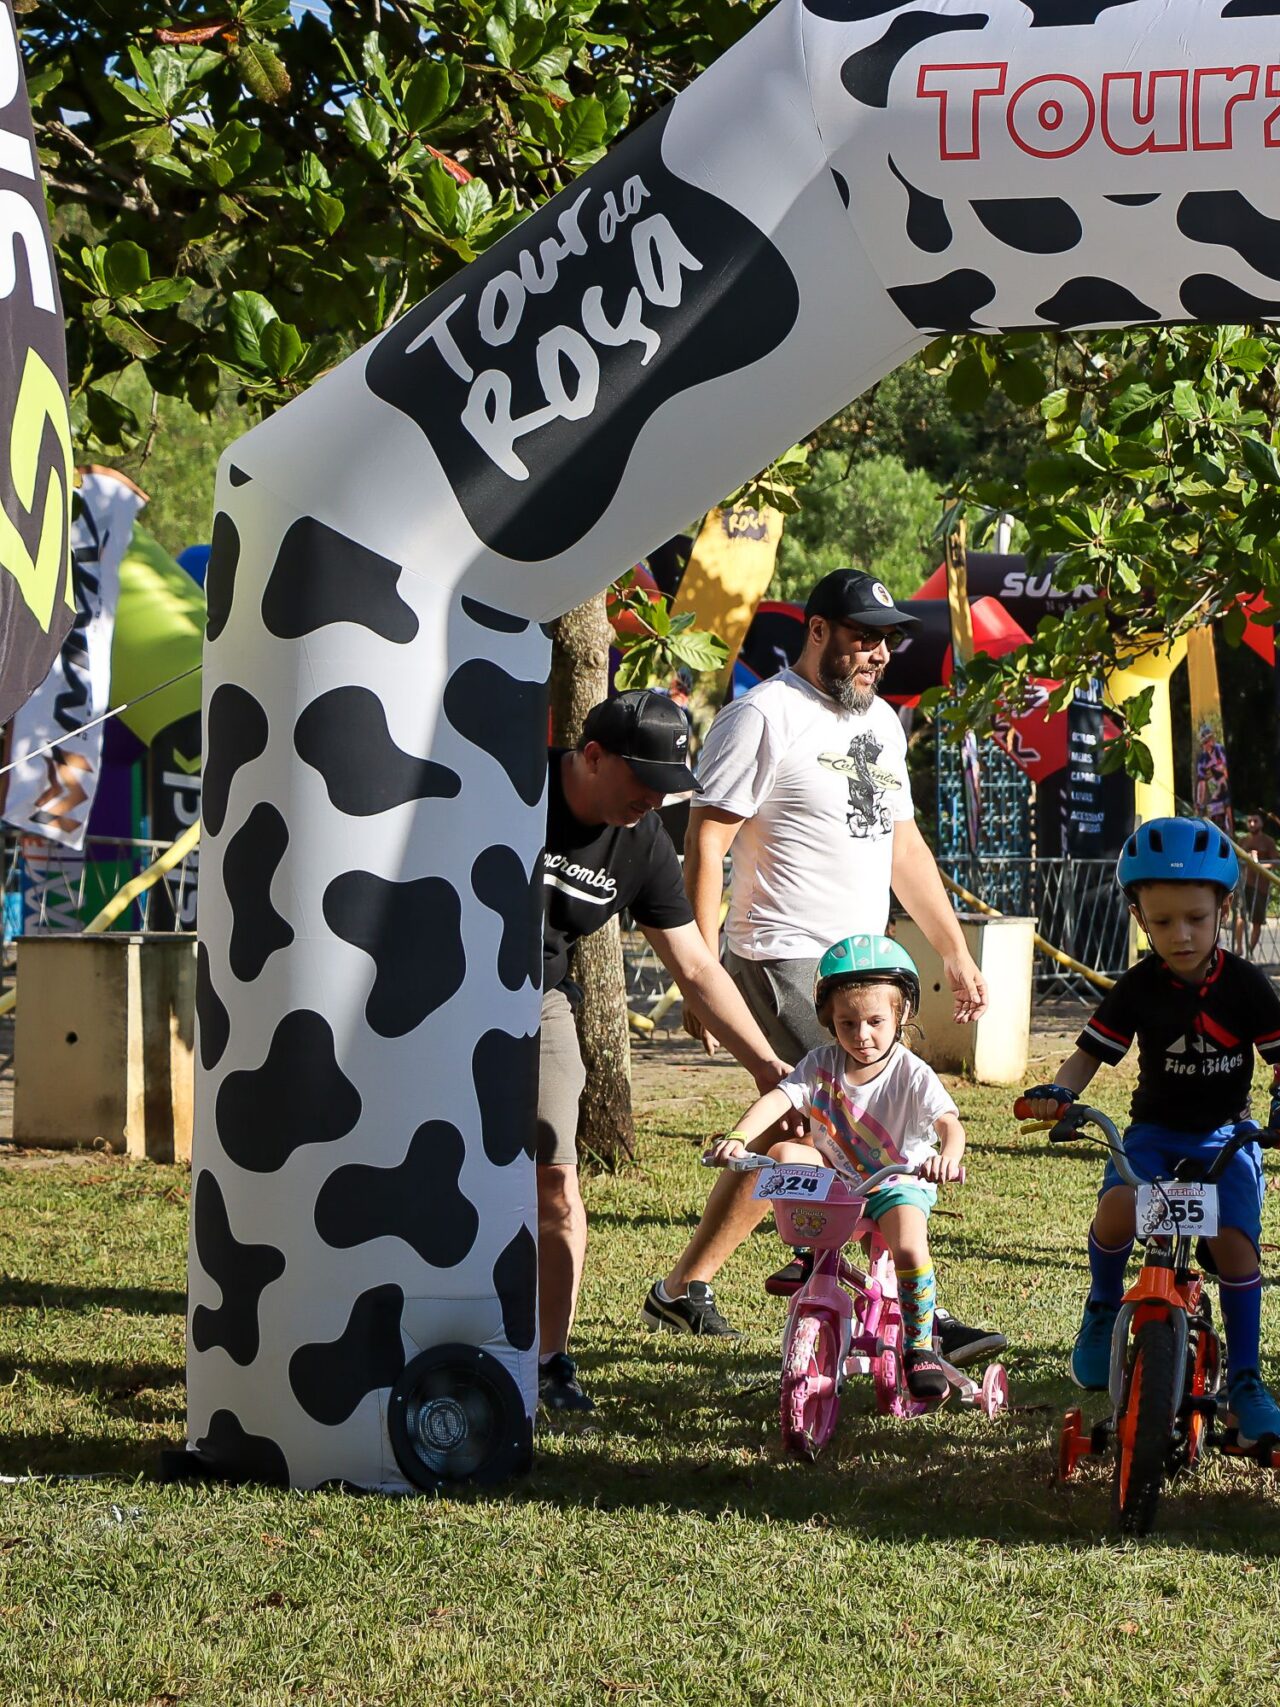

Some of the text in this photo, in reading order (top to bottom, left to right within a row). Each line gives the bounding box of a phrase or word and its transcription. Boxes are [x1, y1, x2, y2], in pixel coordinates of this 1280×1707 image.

[405, 174, 651, 383] Tour da
[1165, 1058, 1197, 1075] Fire
